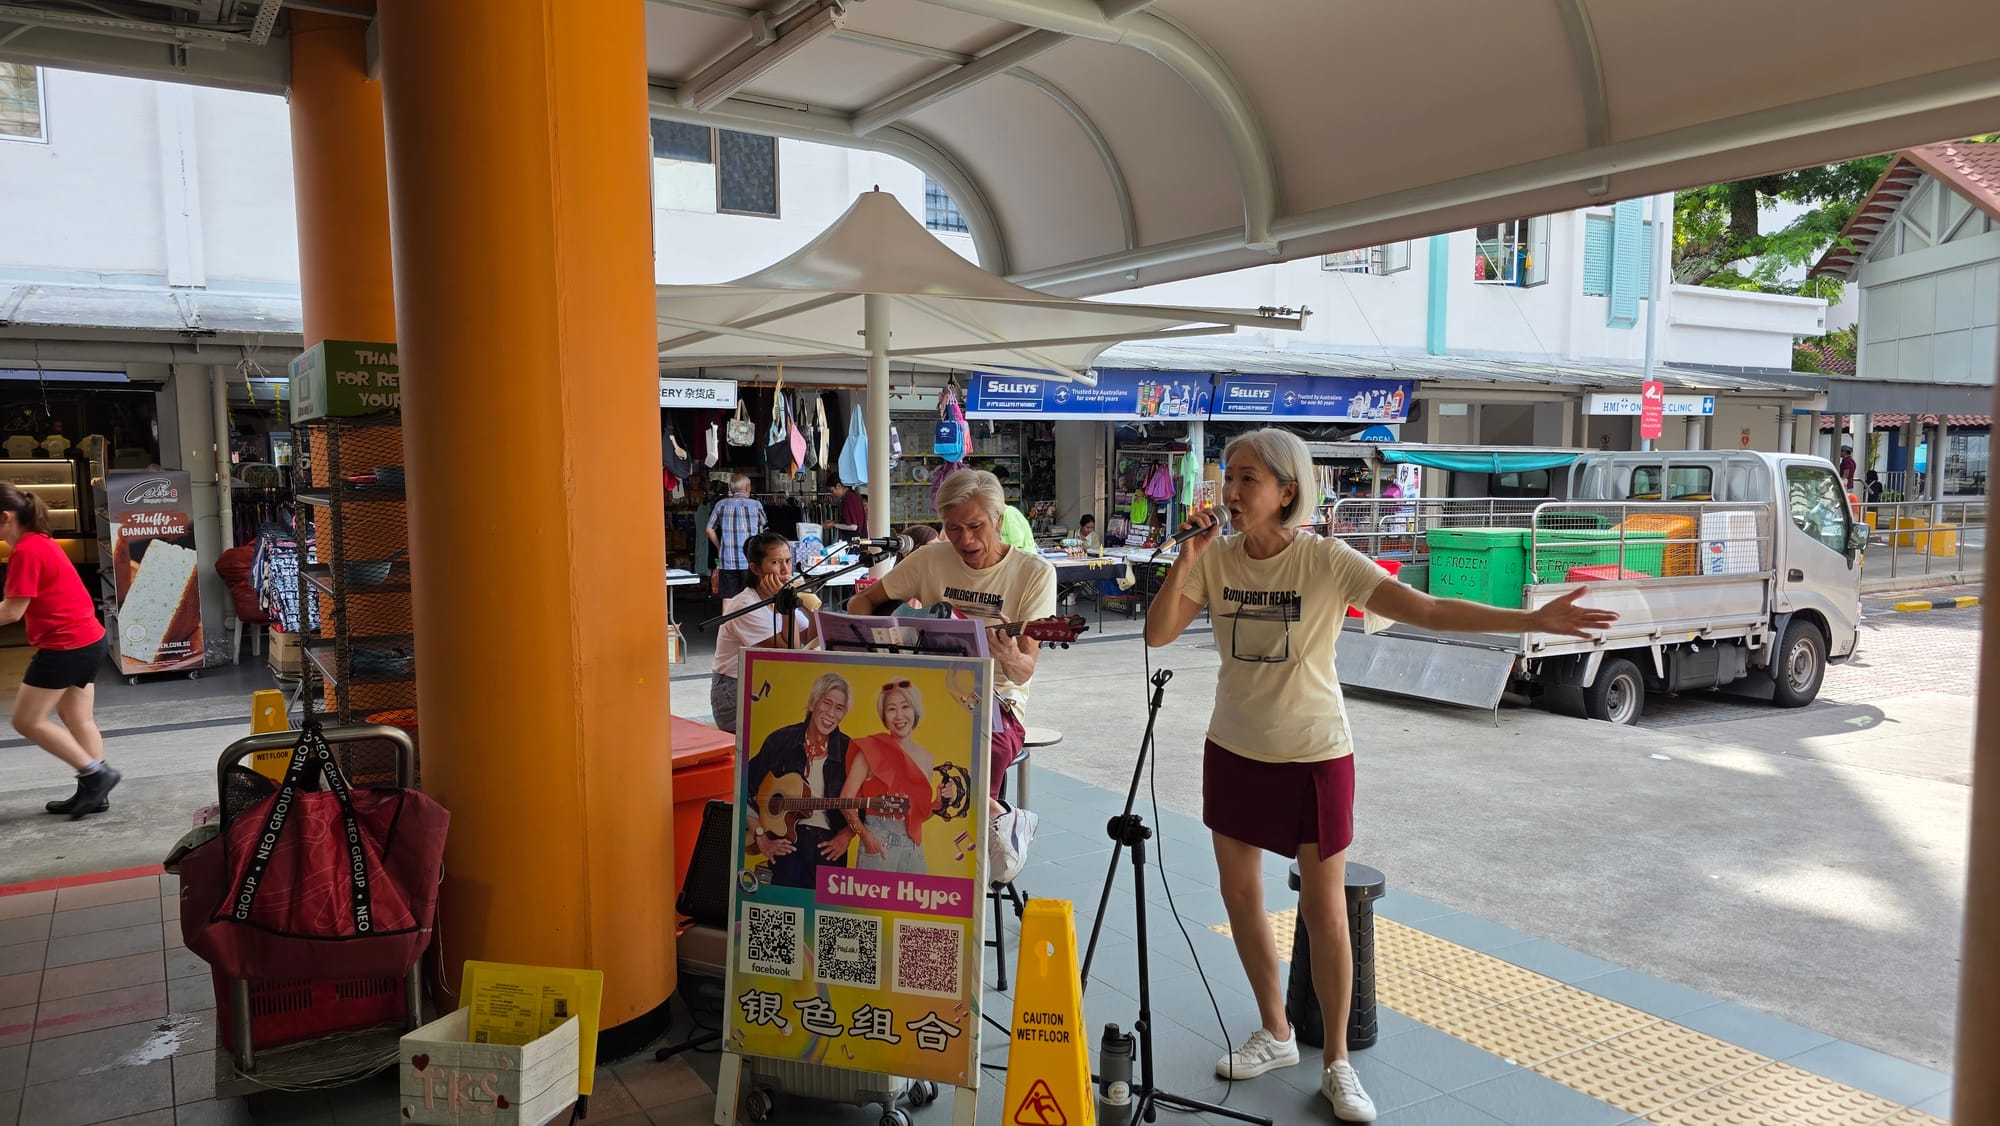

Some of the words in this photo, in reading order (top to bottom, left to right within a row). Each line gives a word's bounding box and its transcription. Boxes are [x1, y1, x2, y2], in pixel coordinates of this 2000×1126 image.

[355, 350, 400, 366] THAN
[336, 371, 370, 386] FOR
[659, 388, 683, 398] ERY
[684, 388, 716, 399] 杂货店
[987, 380, 1038, 394] SELLEYS
[1230, 386, 1271, 398] SELLEYS
[1603, 402, 1619, 412] HMI
[1668, 403, 1693, 412] CLINIC
[131, 512, 172, 525] Fluffy
[122, 526, 159, 536] BANANA
[161, 525, 185, 535] CAKE
[1446, 556, 1488, 570] FROZEN
[944, 586, 979, 603] BURLEIGHT
[978, 591, 1002, 605] HEADS
[1269, 590, 1297, 606] HEADS
[256, 752, 269, 761] WET
[269, 751, 289, 760] FLOOR
[293, 744, 309, 771] NEO
[323, 761, 347, 801] GROUP
[257, 831, 276, 860] NEO
[272, 786, 294, 831] GROUP
[346, 818, 358, 843] NEO
[351, 845, 366, 888] GROUP
[236, 876, 257, 920] GROUP
[827, 873, 891, 899] Silver
[897, 880, 962, 911] Hype
[357, 905, 370, 931] NEO
[751, 962, 791, 977] facebook
[738, 988, 962, 1053] 银色组合
[1023, 1011, 1064, 1026] CAUTION
[1016, 1028, 1036, 1041] WET
[1038, 1029, 1070, 1043] FLOOR
[414, 1068, 498, 1114] TKS
